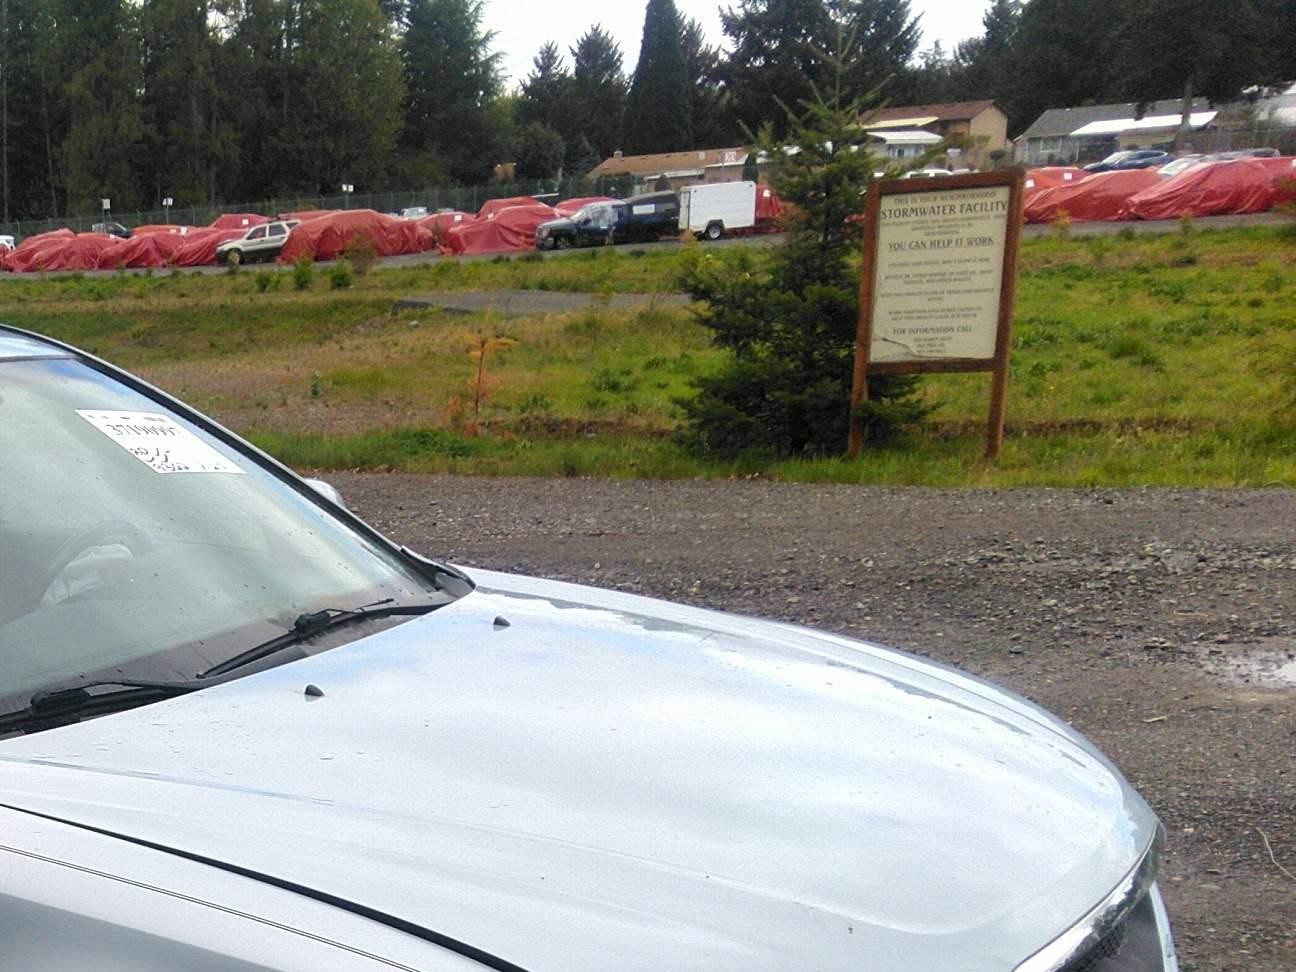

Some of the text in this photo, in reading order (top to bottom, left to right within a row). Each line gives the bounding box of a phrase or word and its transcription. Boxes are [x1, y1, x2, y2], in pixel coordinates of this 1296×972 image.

[880, 199, 1008, 220] STORMWATER FACILITY
[888, 236, 994, 251] YOU CAN HELP IT WORK
[892, 327, 906, 336] FOR
[908, 326, 955, 335] INFORMATION
